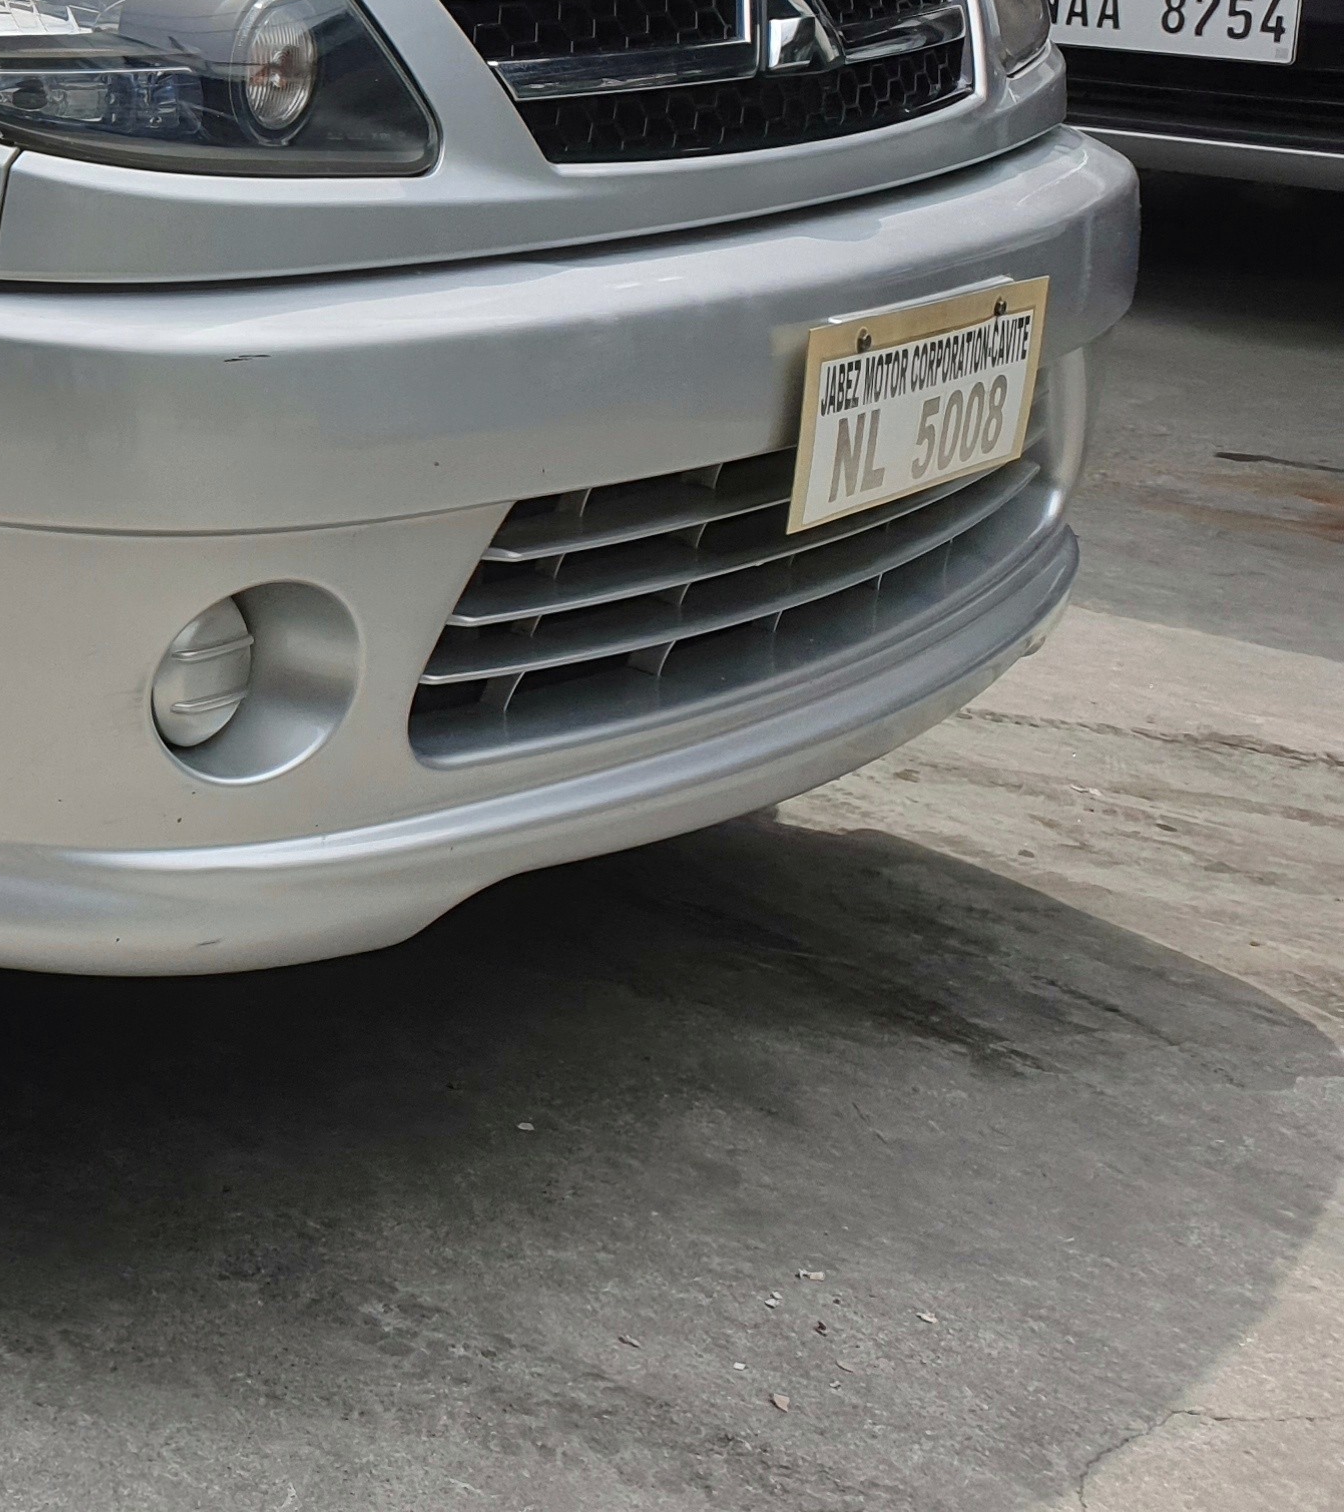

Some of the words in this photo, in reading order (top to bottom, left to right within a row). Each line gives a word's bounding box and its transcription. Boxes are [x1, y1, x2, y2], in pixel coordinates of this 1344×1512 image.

[820, 359, 862, 417] JABEZ
[862, 348, 909, 405] MOTOR
[828, 408, 885, 503] NL
[911, 374, 1008, 479] 5008
